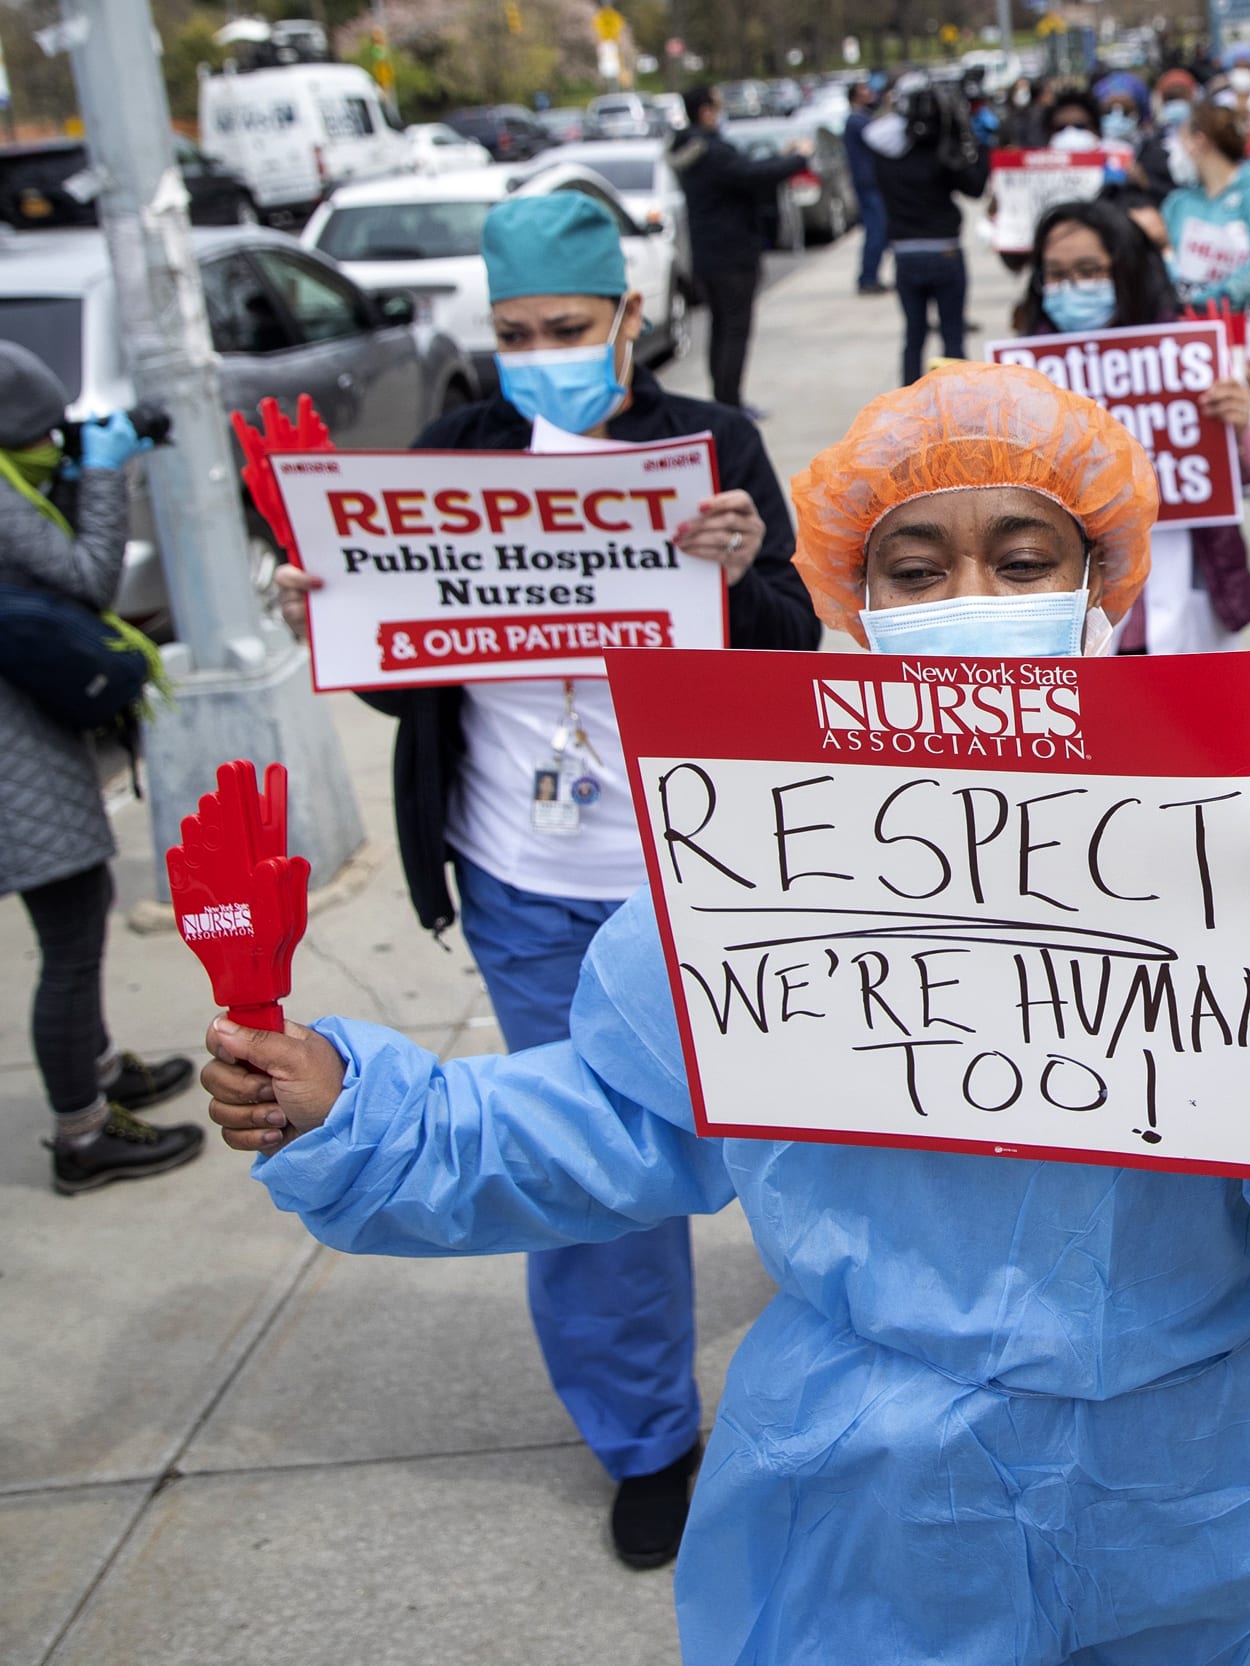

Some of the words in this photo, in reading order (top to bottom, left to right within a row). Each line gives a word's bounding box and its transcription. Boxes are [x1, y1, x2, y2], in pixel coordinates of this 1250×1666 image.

[327, 488, 677, 538] RESPECT
[343, 546, 484, 574] Public
[497, 541, 679, 578] Hospital
[439, 577, 596, 607] Nurses
[391, 632, 417, 660] &
[423, 627, 504, 657] OUR
[507, 620, 661, 651] PATIENTS
[902, 661, 957, 683] New
[960, 662, 1017, 685] York
[1020, 662, 1078, 685] State
[812, 679, 1083, 738] NURSES
[822, 730, 1086, 760] ASSOCIATION
[659, 762, 1242, 930] RESPECT
[182, 909, 252, 936] NURSES
[185, 926, 255, 941] ASSOCIATION
[680, 947, 977, 1036] WE'RE
[852, 1039, 1164, 1145] TOO!
